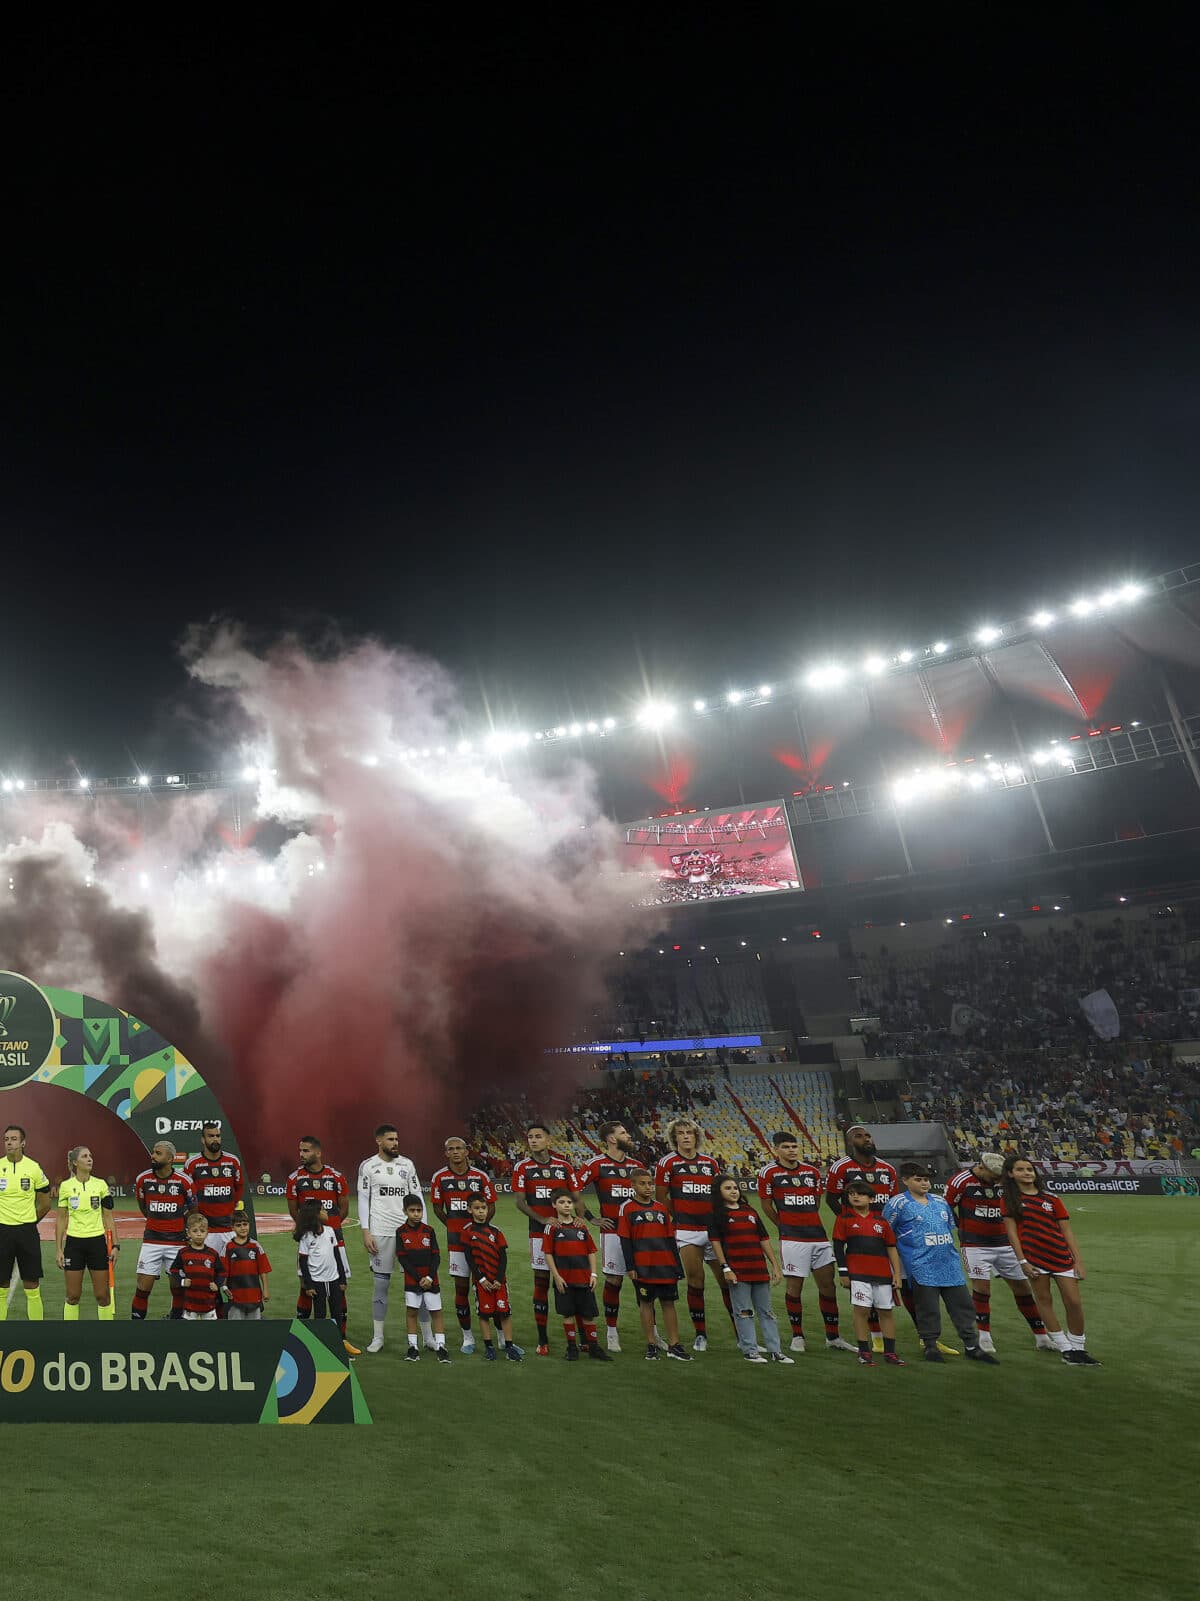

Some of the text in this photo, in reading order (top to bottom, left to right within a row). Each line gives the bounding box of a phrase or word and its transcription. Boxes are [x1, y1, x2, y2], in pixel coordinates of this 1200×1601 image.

[173, 1120, 222, 1131] BETAO
[213, 1186, 231, 1196] BRB
[388, 1186, 406, 1197] BRB
[1046, 1180, 1140, 1192] CopadoBrasilCBF
[622, 1187, 637, 1198] BR
[321, 1199, 333, 1210] RB
[795, 1195, 816, 1206] BRB
[157, 1202, 178, 1213] BRB
[987, 1207, 1001, 1218] BR
[43, 1352, 92, 1392] do
[102, 1352, 255, 1391] BRASIL
